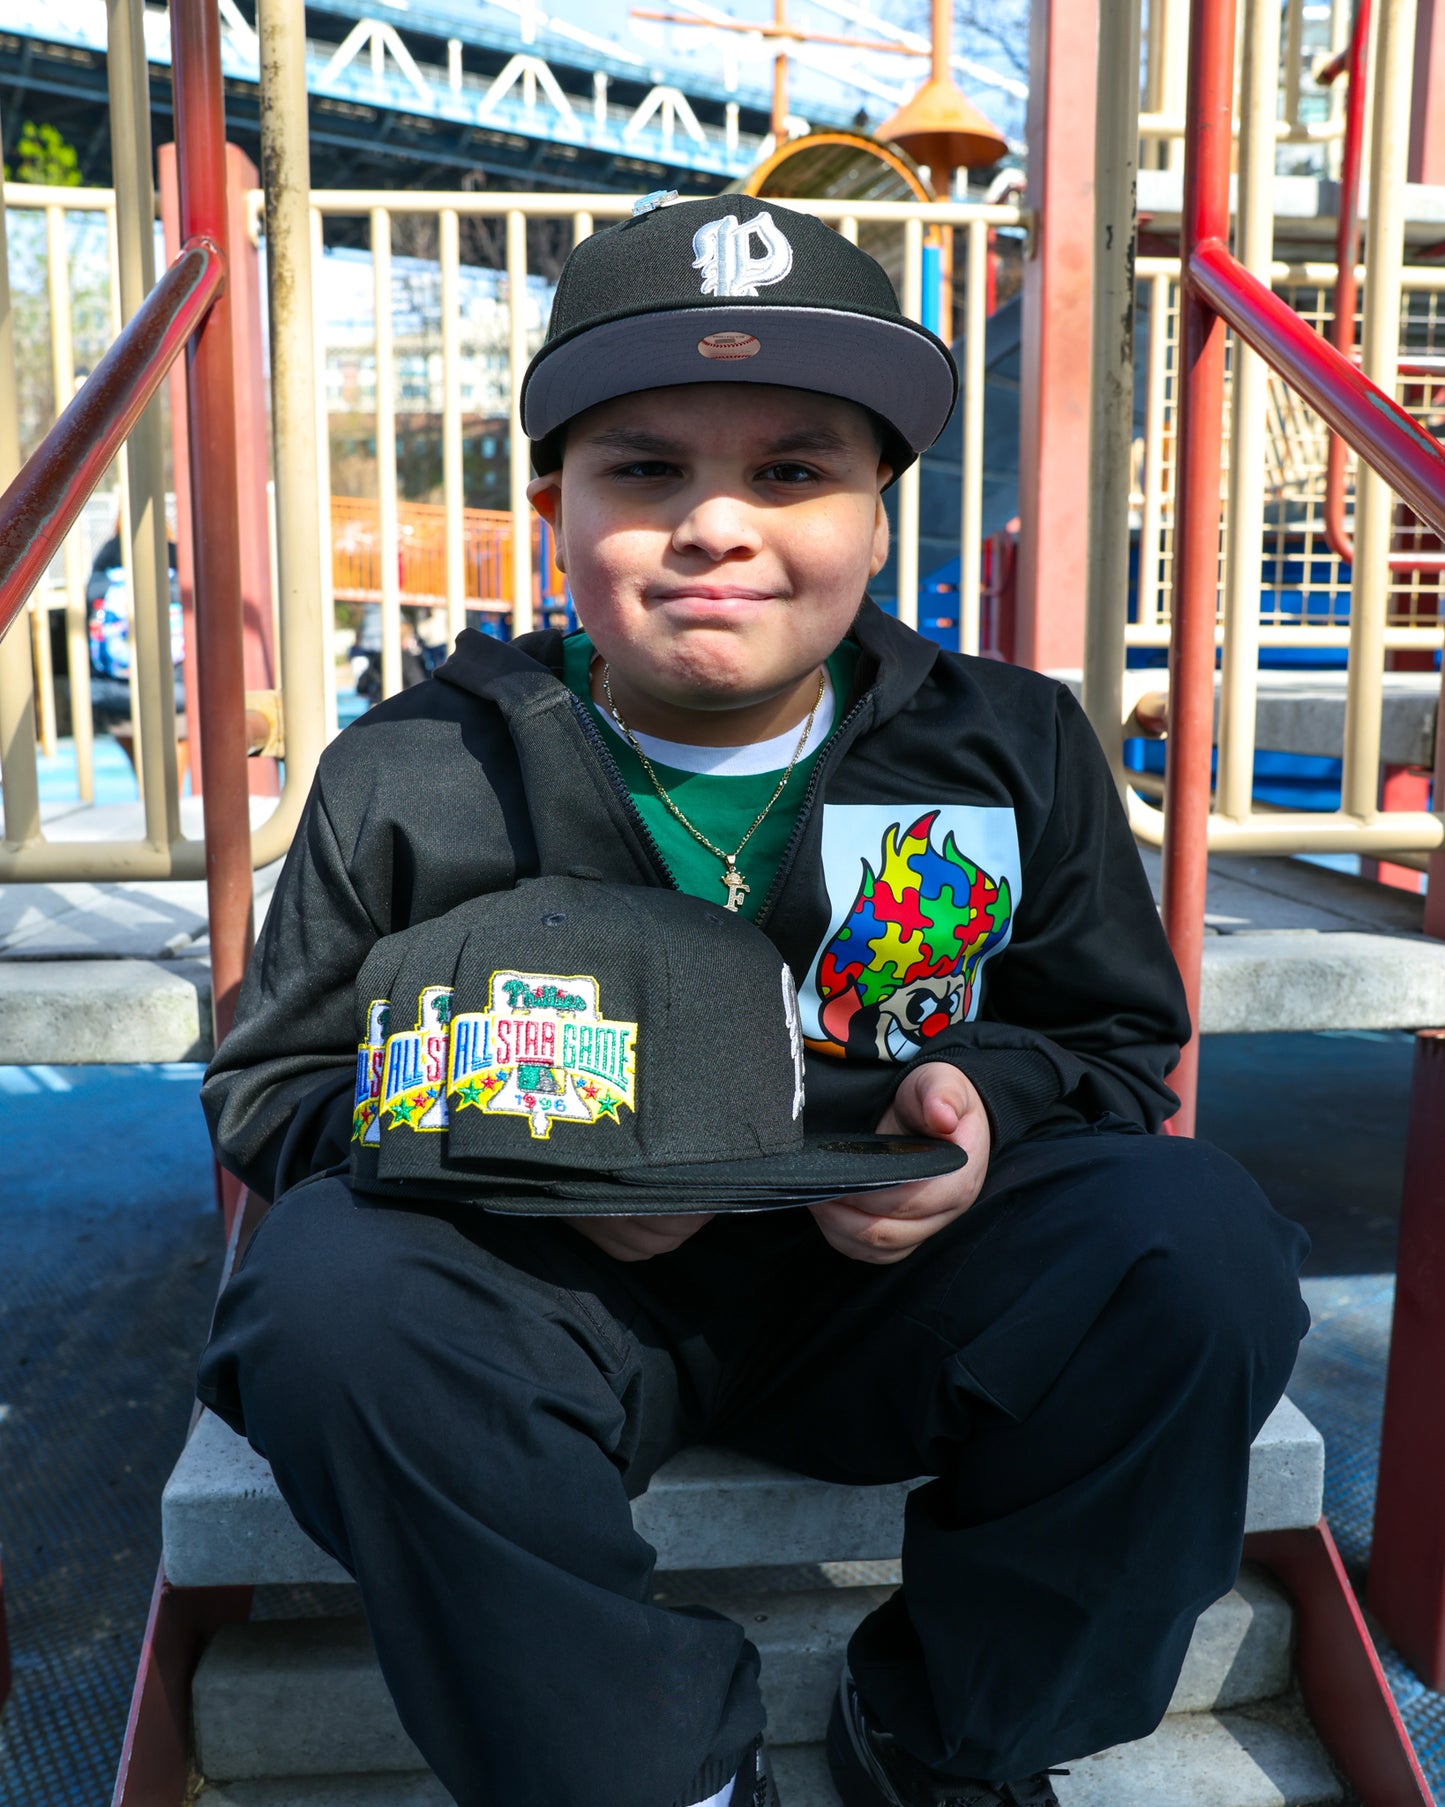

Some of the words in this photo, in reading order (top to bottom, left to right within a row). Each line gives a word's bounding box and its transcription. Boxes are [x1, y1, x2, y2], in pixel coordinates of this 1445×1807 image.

[502, 979, 587, 1012] Phillies
[386, 1038, 423, 1101] ALL
[453, 1020, 493, 1082] ALL
[497, 1020, 555, 1065] STAR
[563, 1023, 630, 1088] GAME
[515, 1093, 567, 1112] 1996
